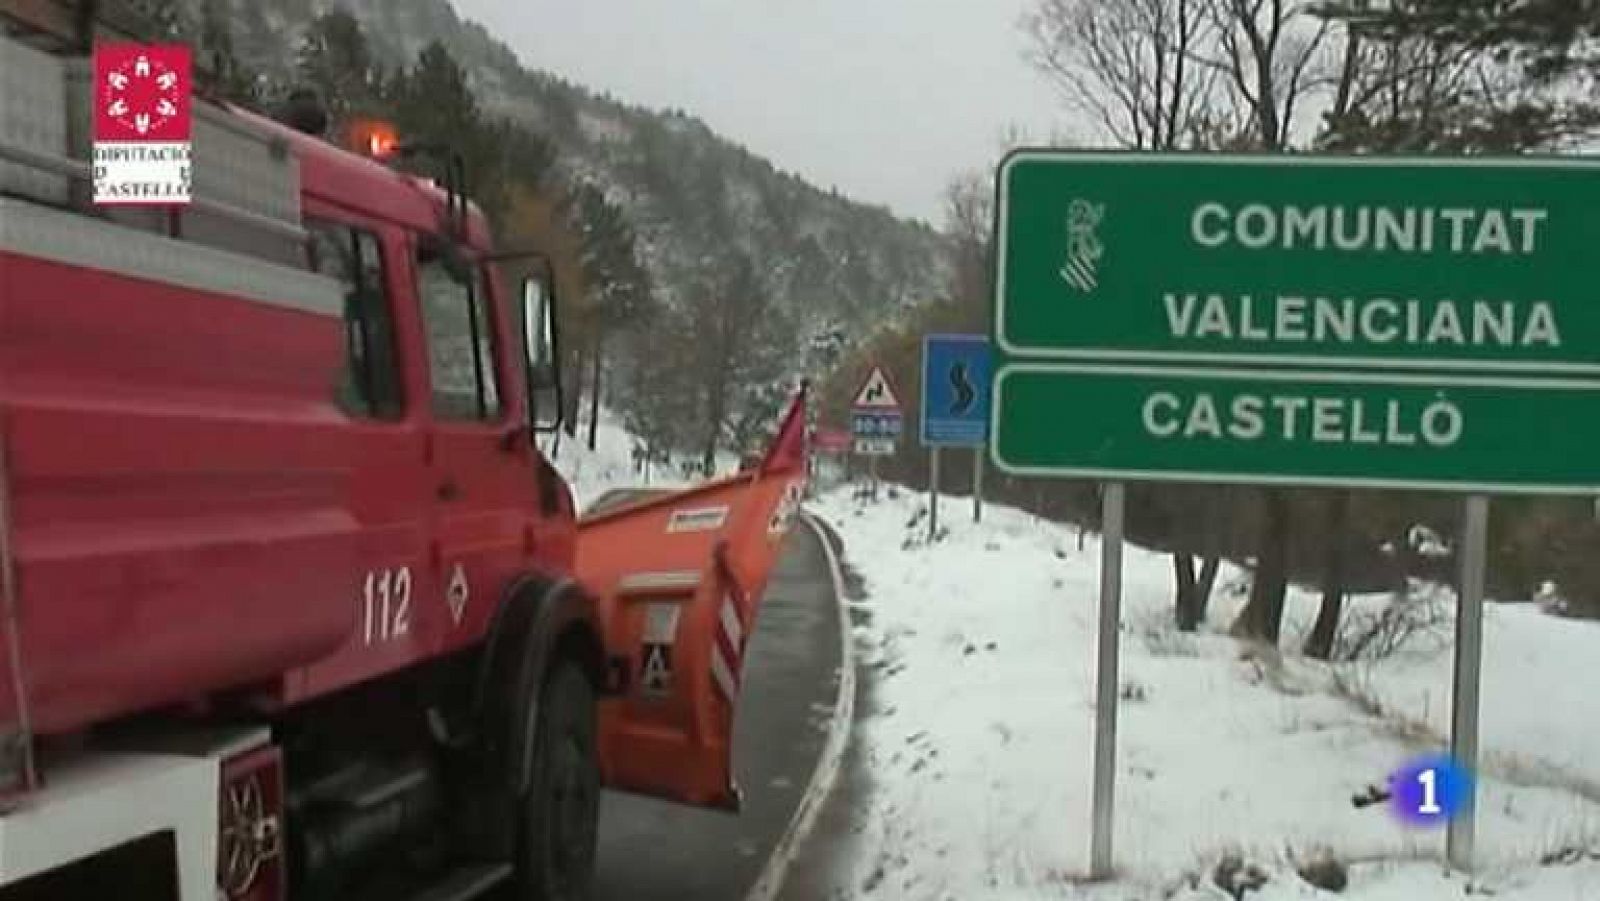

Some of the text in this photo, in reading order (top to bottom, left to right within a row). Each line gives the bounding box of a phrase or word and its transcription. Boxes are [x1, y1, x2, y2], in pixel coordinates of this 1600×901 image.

[1191, 202, 1548, 253] COMUNITAT
[1164, 294, 1561, 346] VALENCIANA
[362, 566, 411, 645] 112
